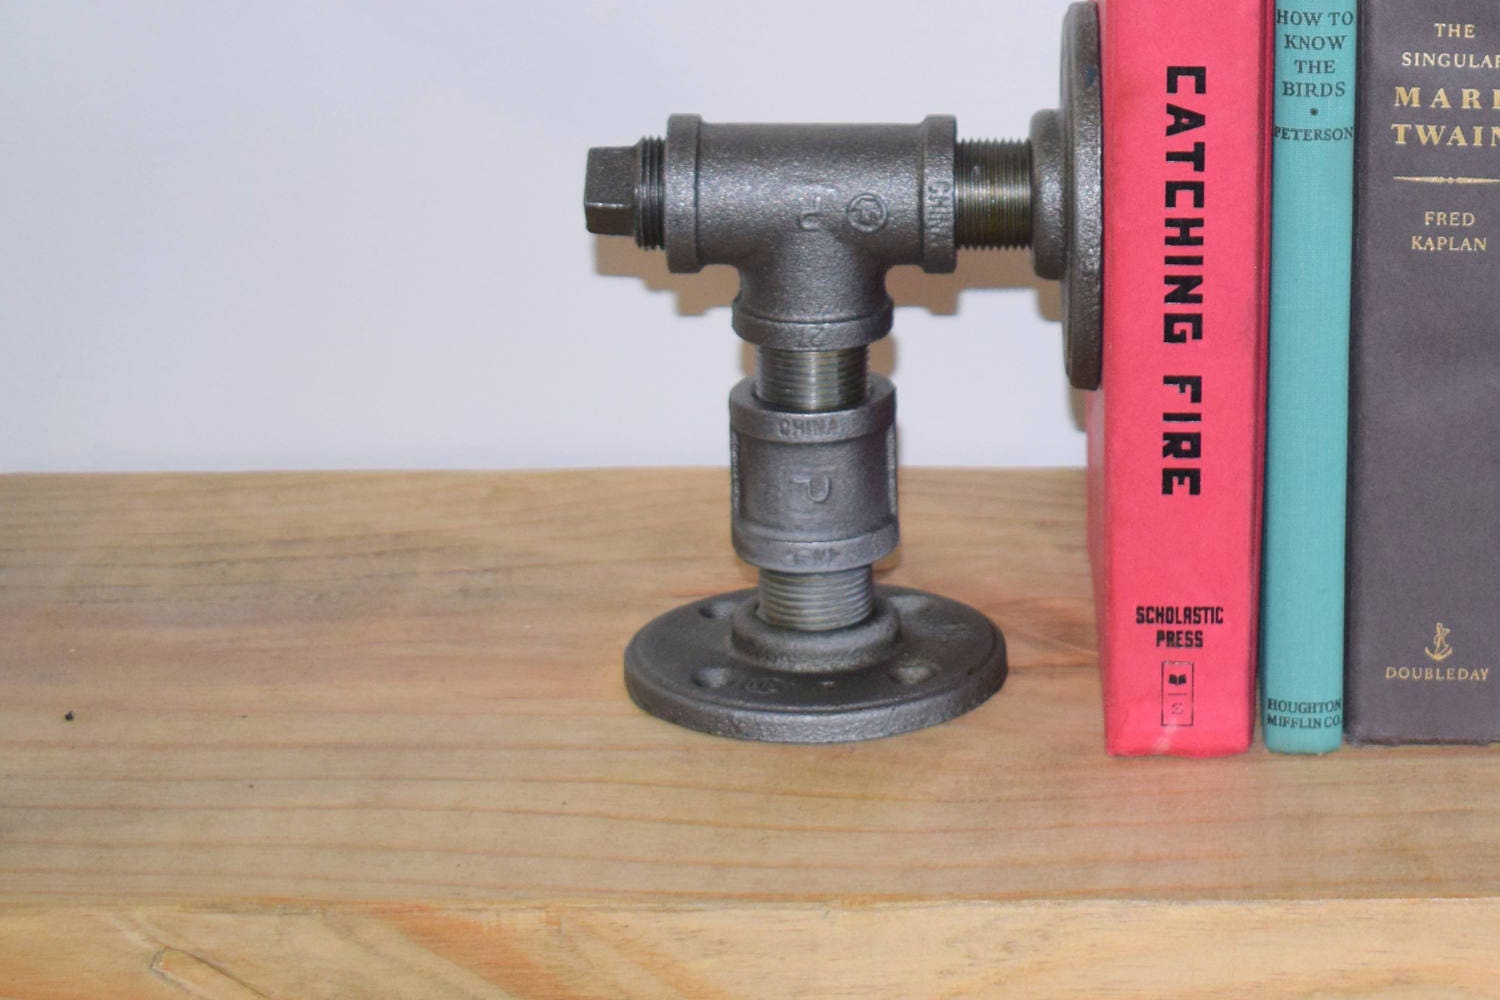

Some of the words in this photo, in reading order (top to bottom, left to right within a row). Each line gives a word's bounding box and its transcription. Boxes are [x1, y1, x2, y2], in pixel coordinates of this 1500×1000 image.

[1276, 8, 1325, 27] HOW
[1328, 10, 1354, 27] TO
[1433, 22, 1476, 39] THE
[1284, 34, 1348, 51] KNOW
[1294, 59, 1336, 75] THE
[1281, 81, 1346, 98] BIRDS
[1274, 125, 1354, 142] PETERSON
[1163, 65, 1207, 345] CATCHING
[1424, 211, 1476, 227] FRED
[1411, 235, 1488, 251] KAPLAN
[1161, 374, 1203, 496] FIRE
[1136, 605, 1224, 626] SCHOLASTIC
[1156, 630, 1204, 649] PRESS
[1385, 666, 1489, 682] DOUBLEDAY
[1267, 698, 1342, 714] HOUGHTON
[1267, 714, 1322, 729] MIFFLIN
